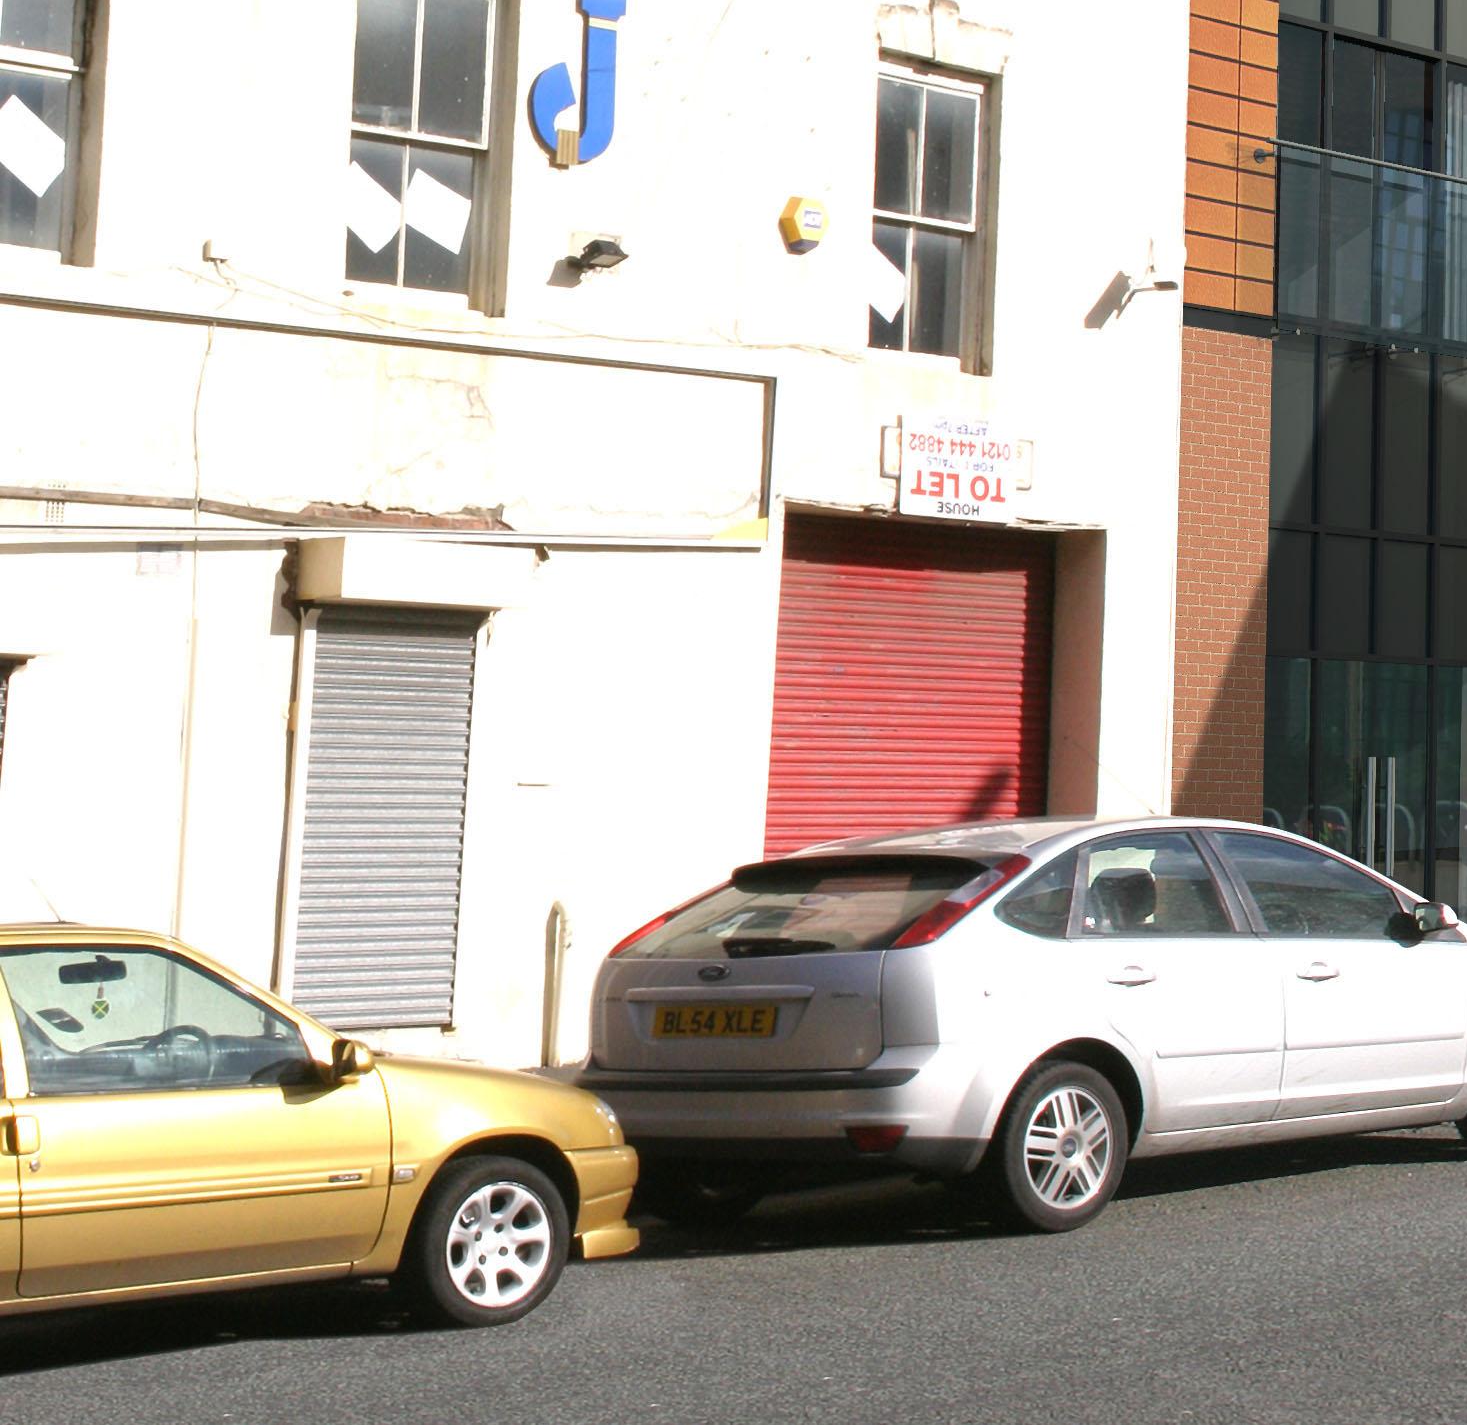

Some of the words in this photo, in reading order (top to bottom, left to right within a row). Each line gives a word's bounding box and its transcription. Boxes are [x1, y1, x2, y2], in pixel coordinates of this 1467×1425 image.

[956, 424, 987, 436] AFTER
[909, 433, 945, 454] 4882
[950, 438, 977, 457] 444
[981, 441, 1011, 461] 0121
[910, 469, 960, 499] LET
[970, 475, 1006, 503] TO
[936, 501, 980, 516] HOUSE
[661, 1010, 716, 1034] BL54
[721, 1009, 766, 1033] XLE
